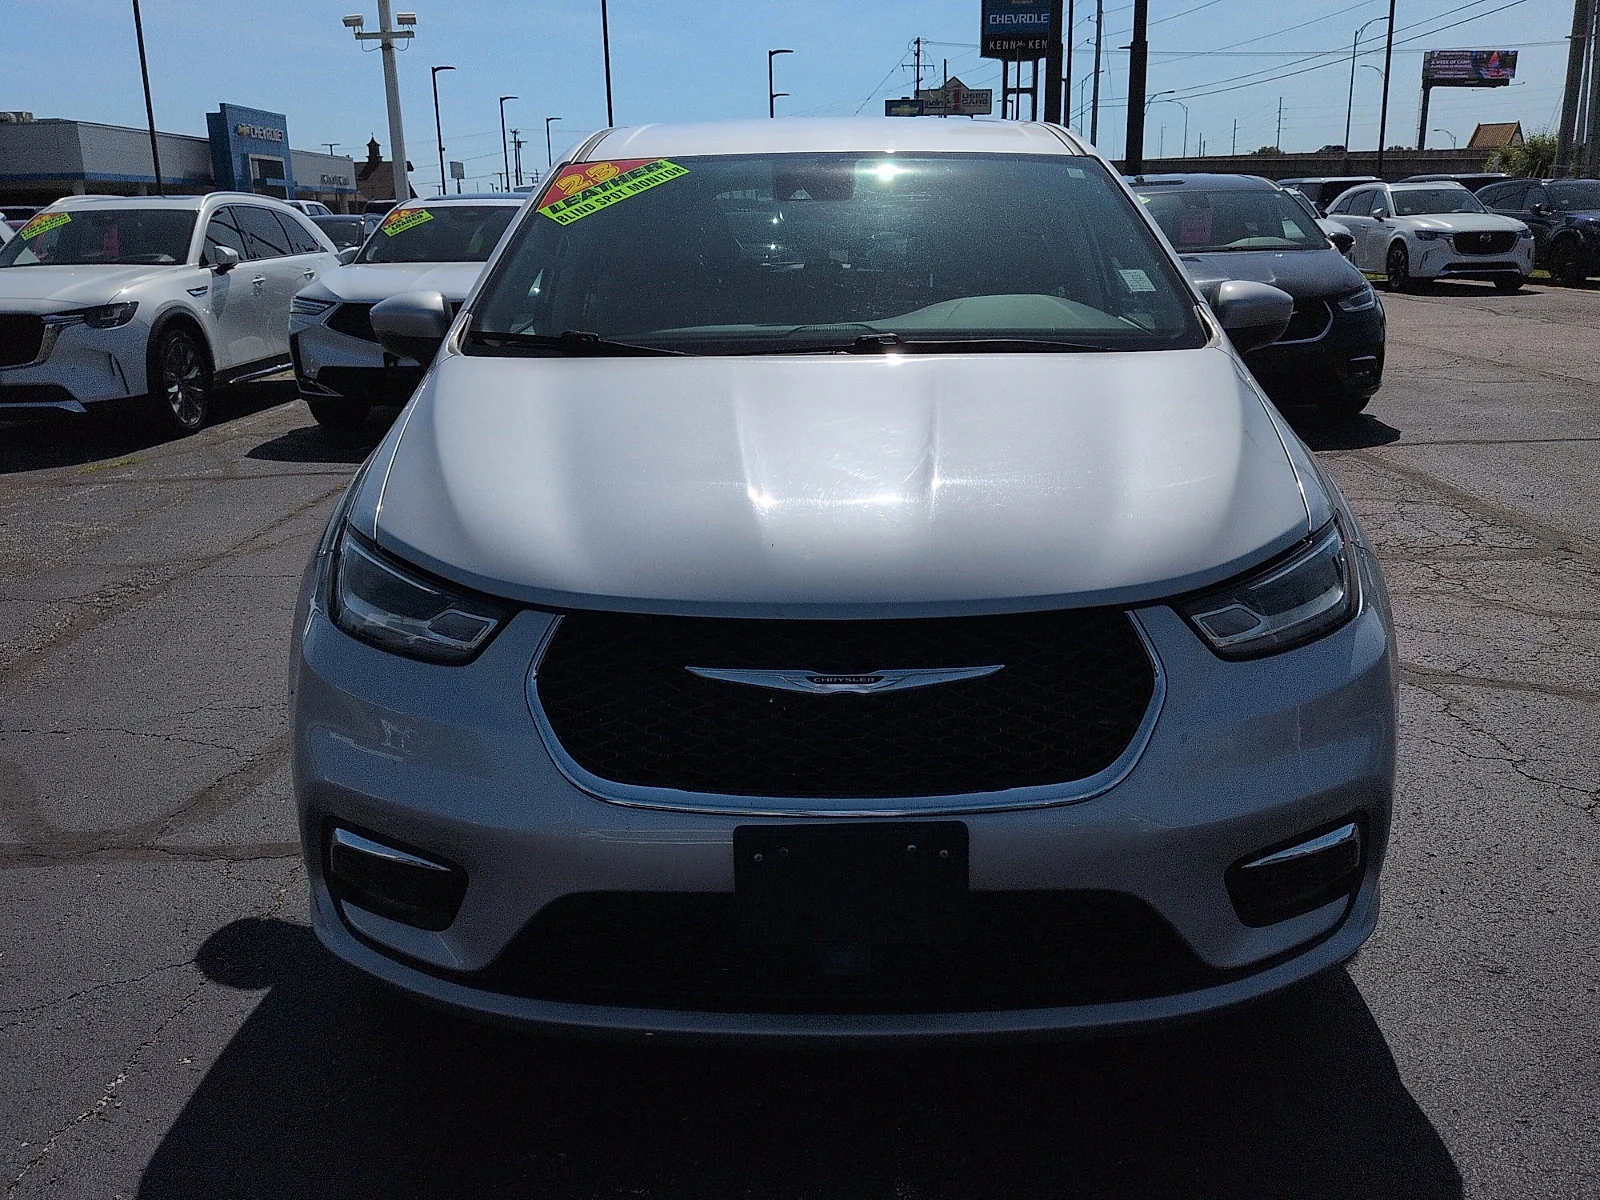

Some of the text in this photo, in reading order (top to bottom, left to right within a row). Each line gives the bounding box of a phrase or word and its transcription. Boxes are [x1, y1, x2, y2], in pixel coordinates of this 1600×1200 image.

[989, 13, 1050, 24] CHEVROLE
[1028, 39, 1048, 49] KEN
[547, 160, 666, 215] LEATHER
[555, 166, 684, 224] BLIND SPOT MONITOR
[556, 162, 620, 195] 23
